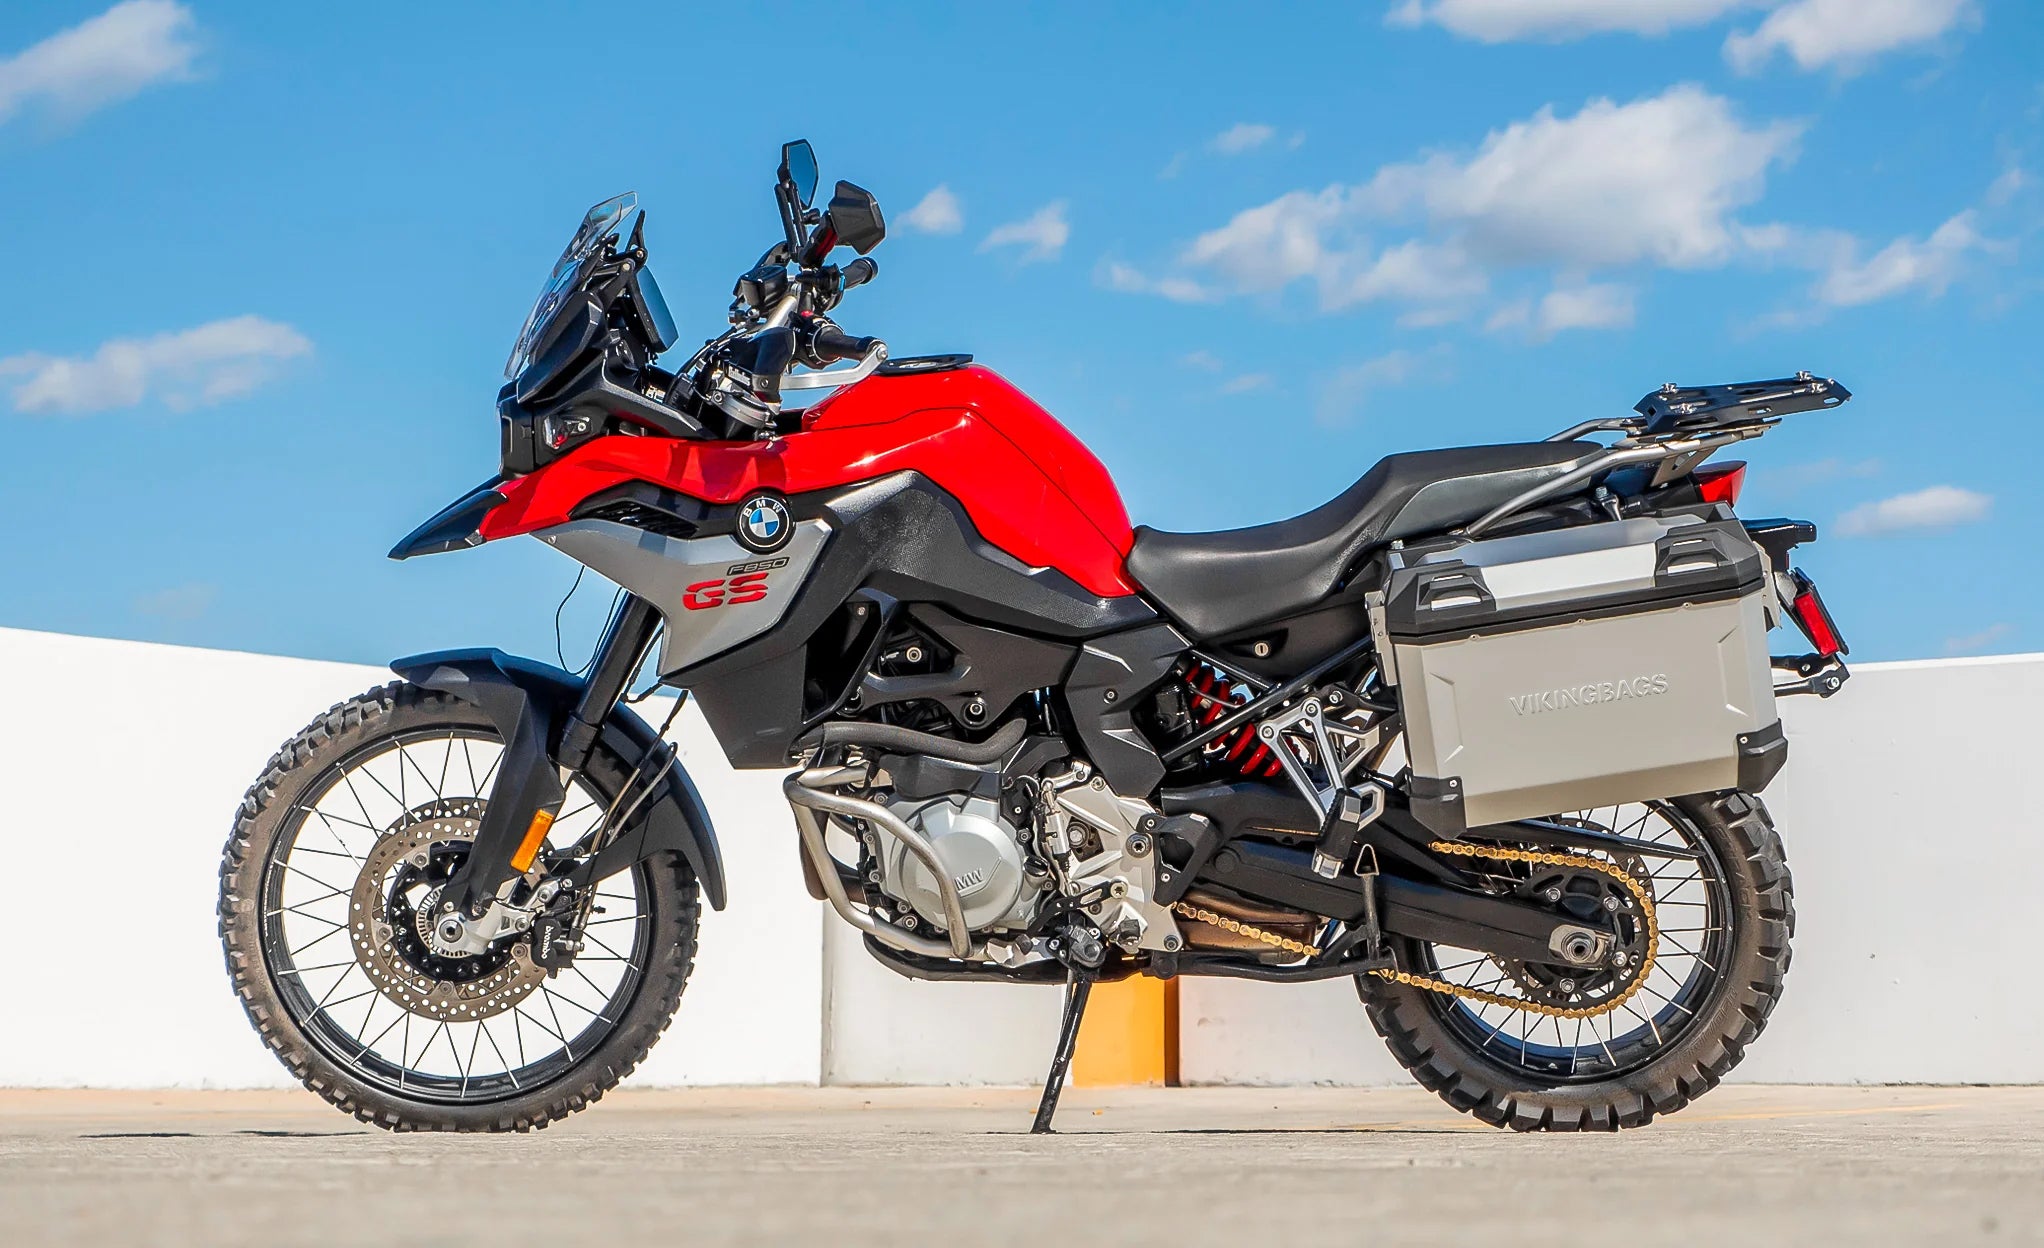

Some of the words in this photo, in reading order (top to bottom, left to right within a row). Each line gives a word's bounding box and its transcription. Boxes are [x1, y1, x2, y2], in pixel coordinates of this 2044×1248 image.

[743, 499, 783, 518] BMW
[727, 557, 790, 576] F850
[682, 572, 769, 611] GS
[1509, 673, 1669, 716] VIKINGBAGS
[954, 867, 983, 891] MW
[541, 925, 554, 959] brembo
